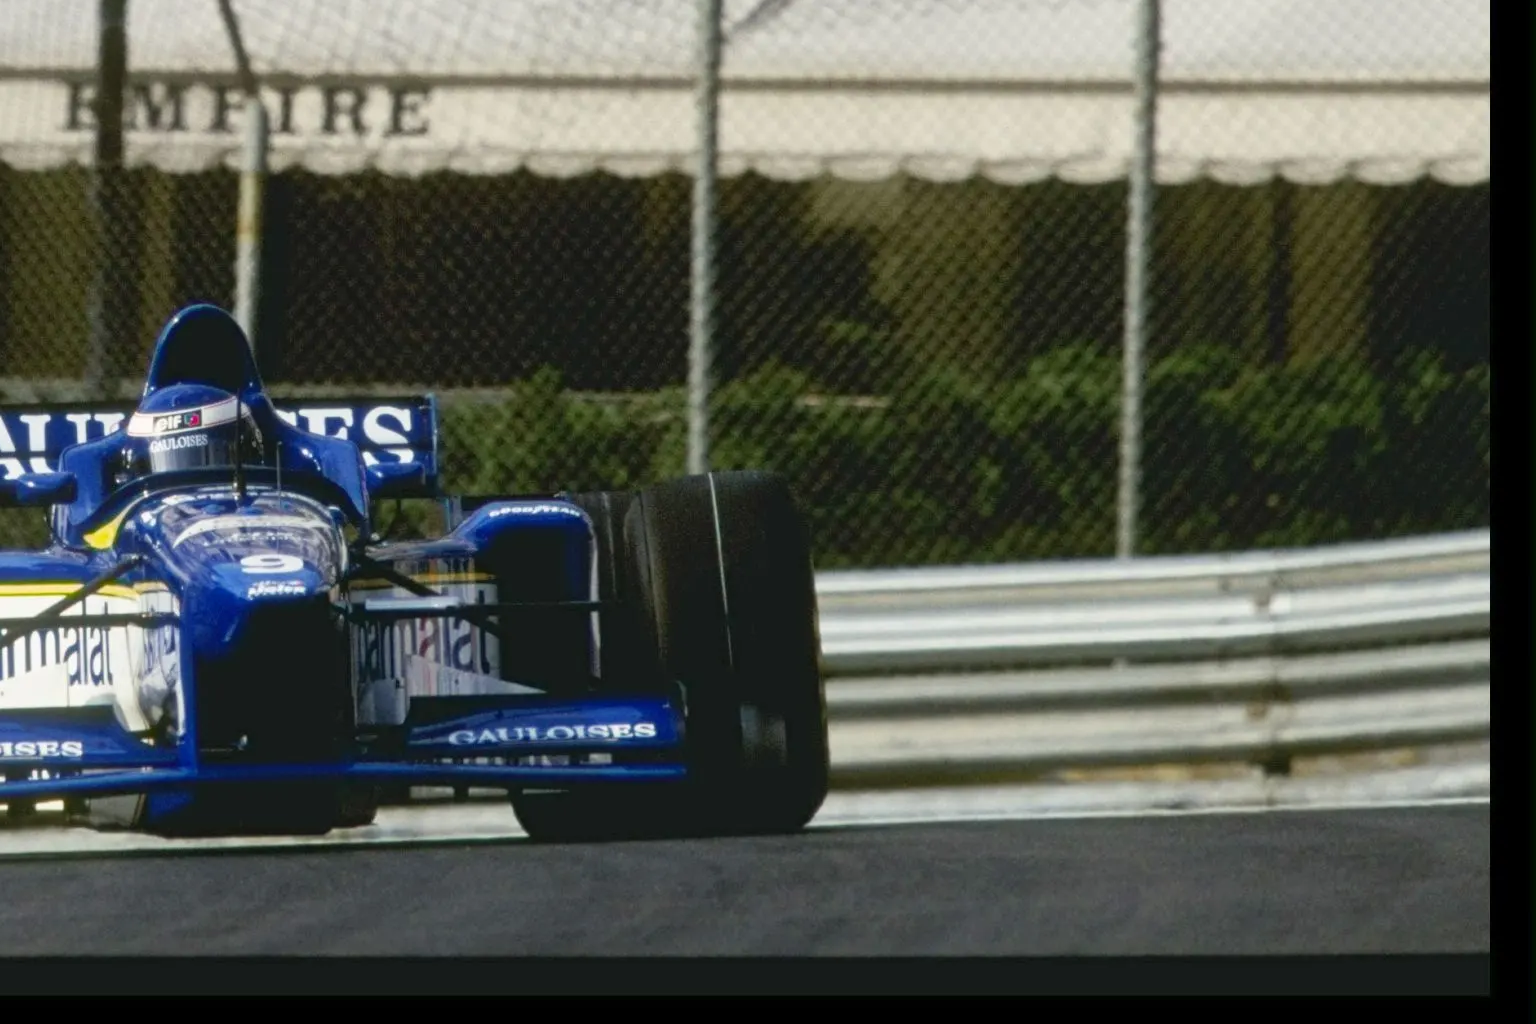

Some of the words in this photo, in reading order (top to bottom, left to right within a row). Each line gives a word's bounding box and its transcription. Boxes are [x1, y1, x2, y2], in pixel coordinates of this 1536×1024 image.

[155, 414, 182, 433] elf
[150, 434, 209, 453] GAULOISES
[240, 553, 304, 574] 9
[448, 723, 656, 745] GAULOISES
